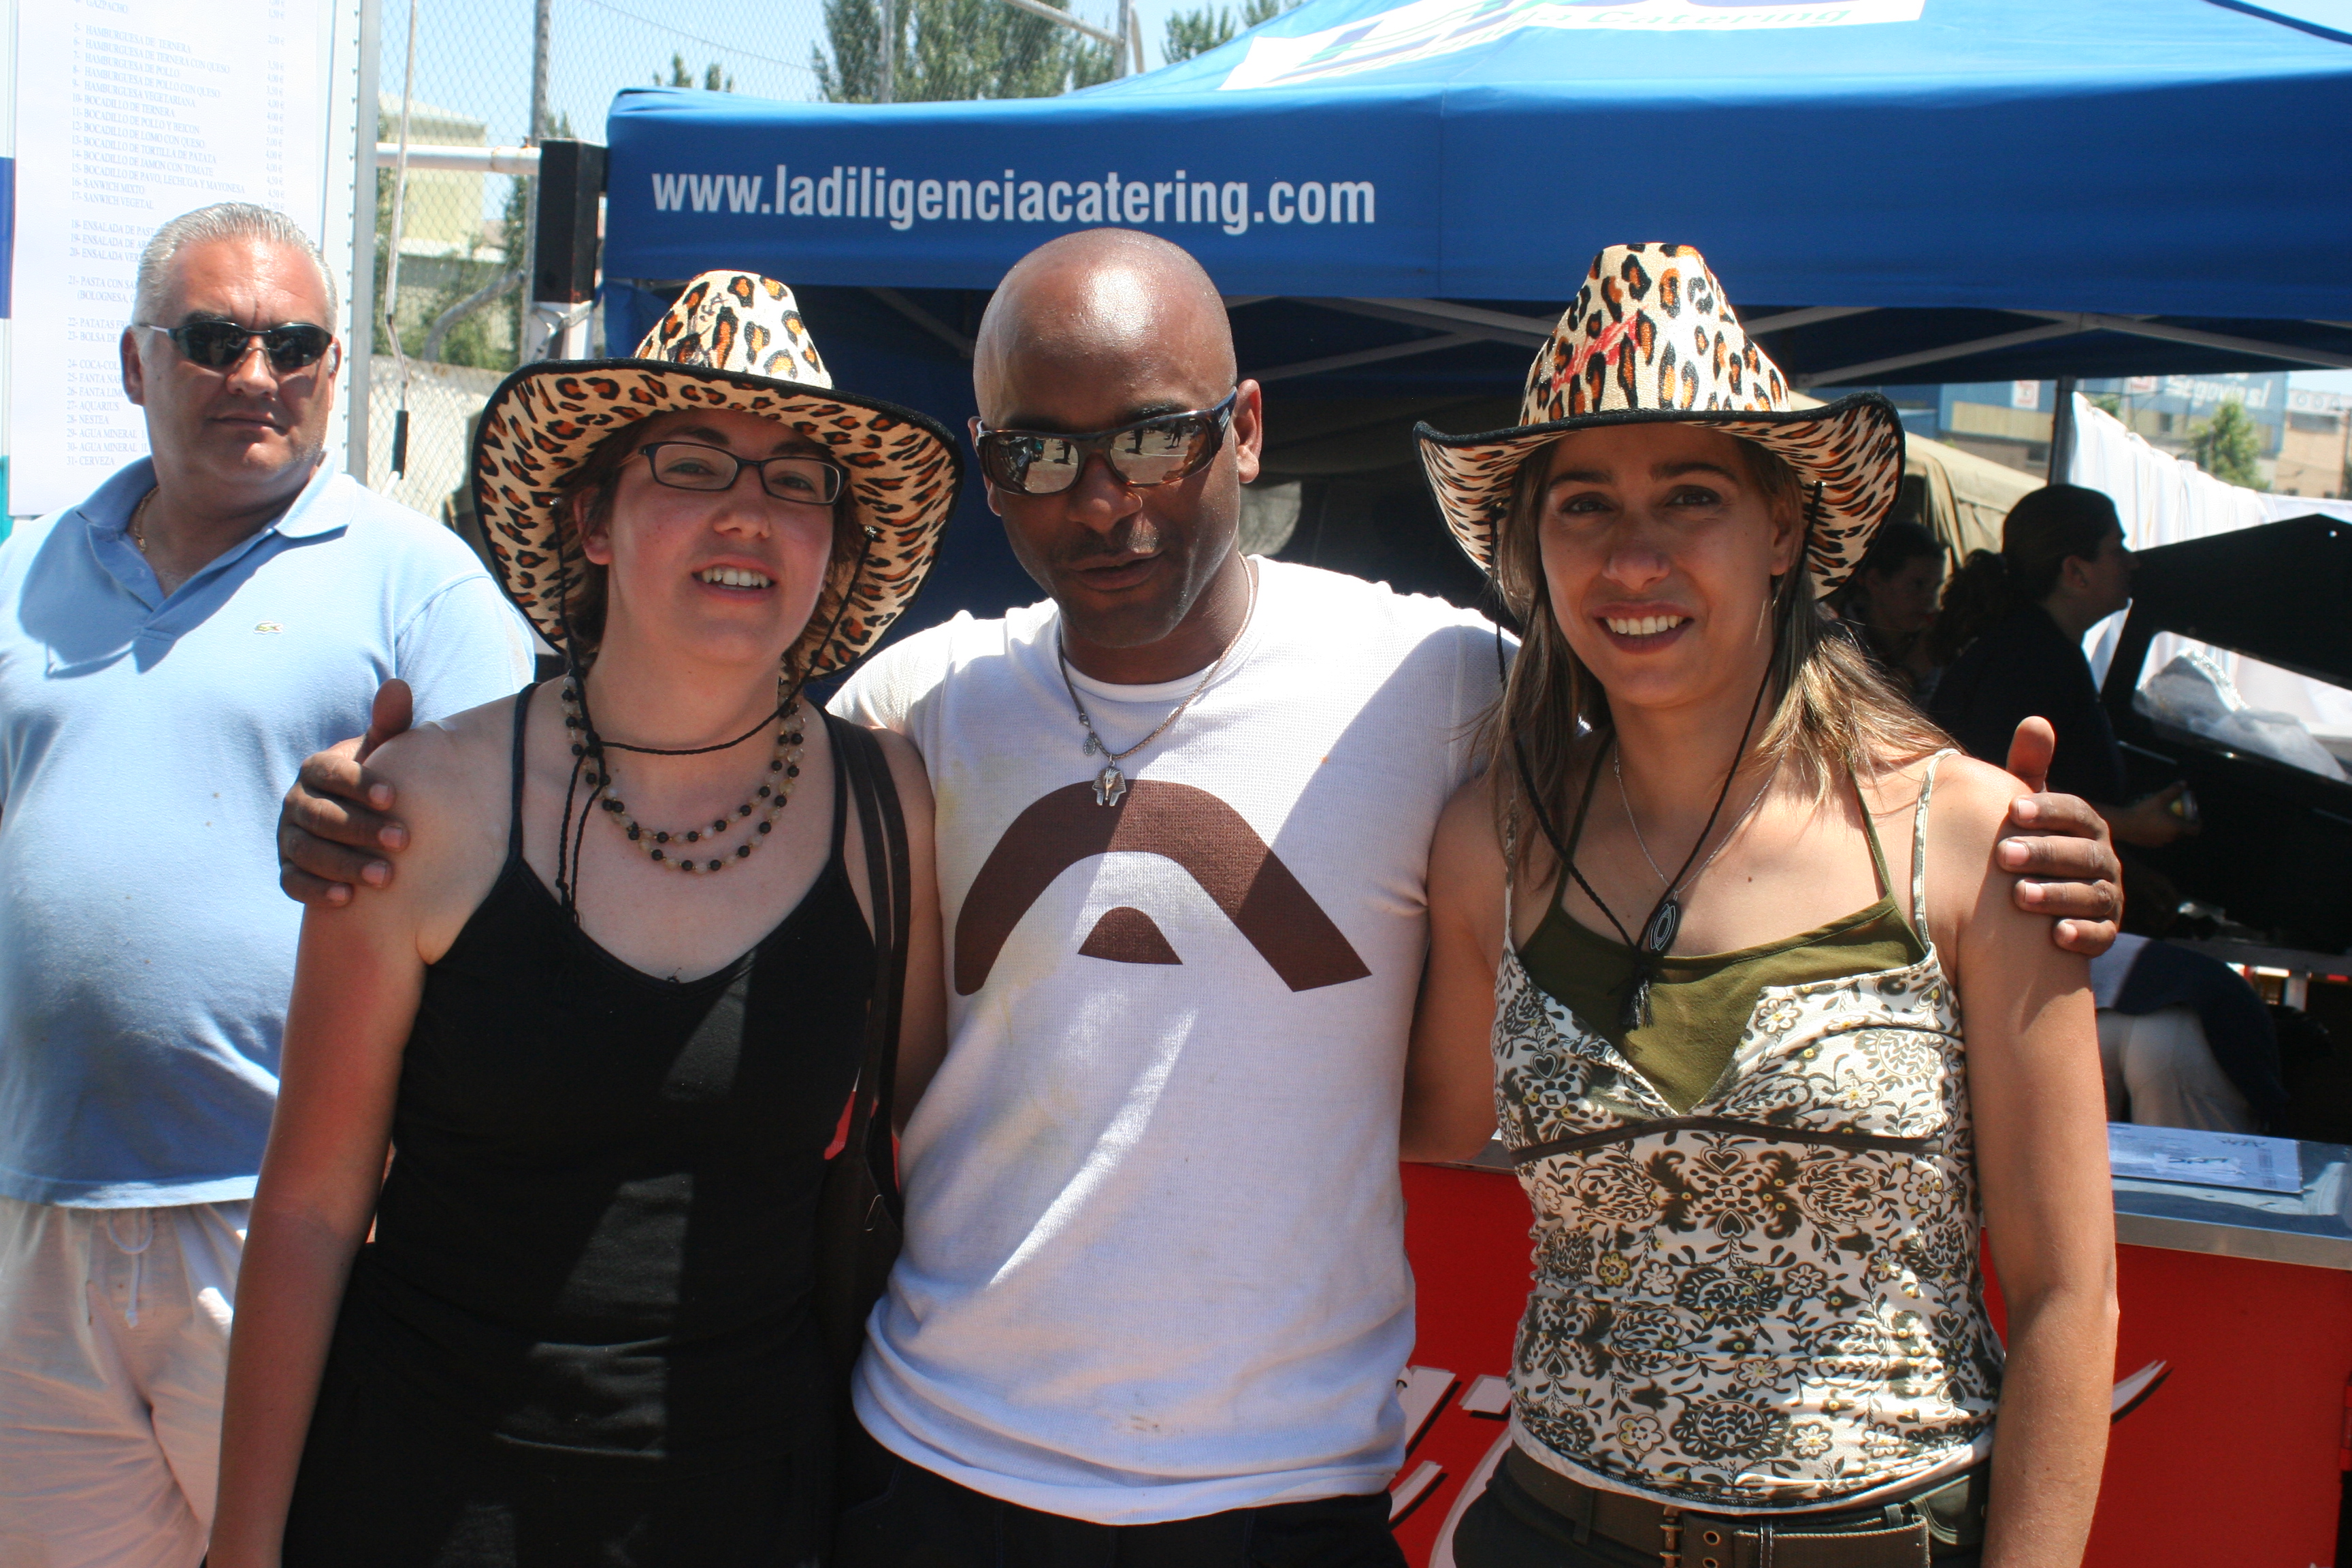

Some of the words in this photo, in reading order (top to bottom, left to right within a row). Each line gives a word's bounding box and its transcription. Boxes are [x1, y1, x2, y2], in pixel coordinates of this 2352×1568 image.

[86, 0, 128, 14] GAZPACHO
[1588, 10, 1852, 24] Catering
[86, 24, 144, 44] HAMBURGUESA
[146, 36, 155, 46] DE
[159, 39, 191, 53] TERNERA
[85, 39, 144, 58] HAMBURGUESA
[146, 50, 154, 60] DE
[157, 51, 190, 66] TERNERA
[191, 59, 206, 69] CON
[207, 61, 230, 74] QUESO
[85, 53, 143, 72] HAMBURGUESA
[145, 63, 154, 74] DE
[156, 65, 180, 78] POLLO
[84, 67, 143, 86] HAMBURGUESA
[144, 76, 154, 86] DE
[156, 79, 179, 91] POLLO
[180, 83, 196, 94] CON
[197, 85, 220, 98] QUESO
[84, 80, 143, 99] HAMBURGUESA
[144, 90, 196, 108] VEGETARIANA
[84, 95, 129, 110] BOCADILLO
[130, 101, 139, 112] DE
[142, 103, 174, 117] TERNERA
[84, 109, 128, 124] BOCADILLO
[130, 115, 139, 125] DE
[141, 117, 165, 129] POLLO
[166, 120, 172, 129] Y
[173, 122, 200, 134] BEICON
[84, 122, 128, 137] BOCADILLO
[130, 129, 139, 139] DE
[141, 131, 162, 142] LOMO
[164, 135, 179, 144] CON
[181, 136, 205, 148] QUESO
[84, 136, 128, 151] BOCADILLO
[129, 143, 139, 152] DE
[141, 144, 176, 158] TORTILLA
[178, 150, 187, 159] DE
[189, 152, 216, 163] PATATA
[84, 150, 128, 165] BOCADILLO
[129, 157, 138, 166] DE
[140, 159, 165, 170] JAMON
[167, 162, 182, 172] CON
[184, 163, 214, 176] TOMATE
[84, 164, 127, 178] BOCADILLO
[129, 170, 138, 180] DE
[140, 172, 161, 184] PAVO,
[163, 175, 197, 188] LECHUGA
[200, 180, 206, 189] Y
[206, 180, 245, 193] MAYONESA
[84, 178, 118, 191] SANWICH
[120, 184, 144, 194] MIXTO
[84, 192, 118, 205] SANWICH
[121, 197, 154, 209] VEGETAL
[652, 164, 1376, 235] www.ladiligenciacatering.com
[83, 220, 123, 233] ENSALADA
[125, 225, 135, 234] DE
[137, 226, 155, 235] PAST
[83, 234, 123, 247] ENSALADA
[125, 239, 135, 248] DE
[82, 248, 122, 261] ENSALADA
[80, 276, 105, 287] PASTA
[107, 278, 122, 288] CON
[78, 290, 128, 304] (BOLOGNESA,
[80, 317, 114, 329] PATATAS
[80, 331, 105, 342] BOLSA
[107, 333, 117, 342] DE
[80, 359, 120, 370] COCA-COL
[80, 373, 105, 383] FANTA
[79, 387, 105, 397] FANTA
[107, 388, 125, 397] LIMO
[79, 401, 118, 412] AQUARIUS
[79, 414, 109, 424] NESTEA
[79, 429, 101, 438] AGUA
[103, 429, 137, 438] MINERAL
[79, 442, 101, 452] AGUA
[103, 442, 137, 452] MINERAL
[79, 456, 114, 466] CERVEZA
